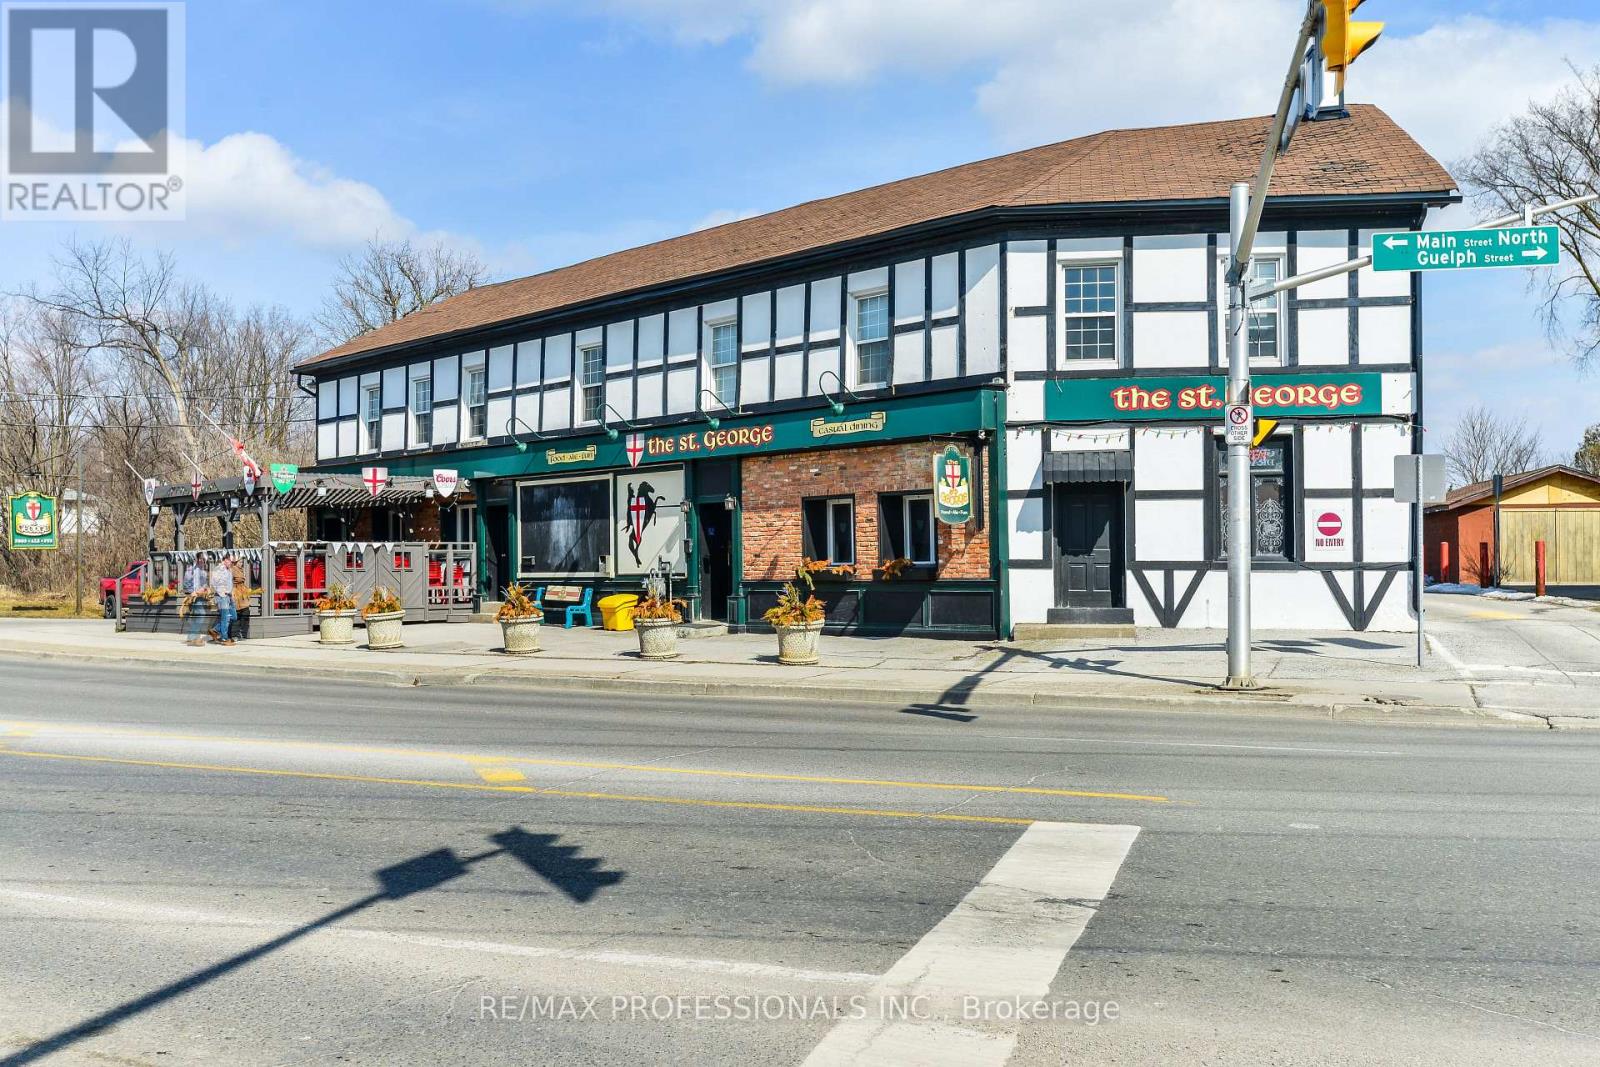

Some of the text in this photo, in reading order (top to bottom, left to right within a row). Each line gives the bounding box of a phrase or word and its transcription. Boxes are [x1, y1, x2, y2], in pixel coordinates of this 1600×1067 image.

[1416, 230, 1548, 249] Main Street North
[1417, 249, 1514, 267] Guelph Street
[1111, 383, 1363, 411] the st. EORGE
[647, 436, 675, 456] the
[703, 425, 774, 451] GEORGE
[1315, 538, 1344, 546] NO ENTRY
